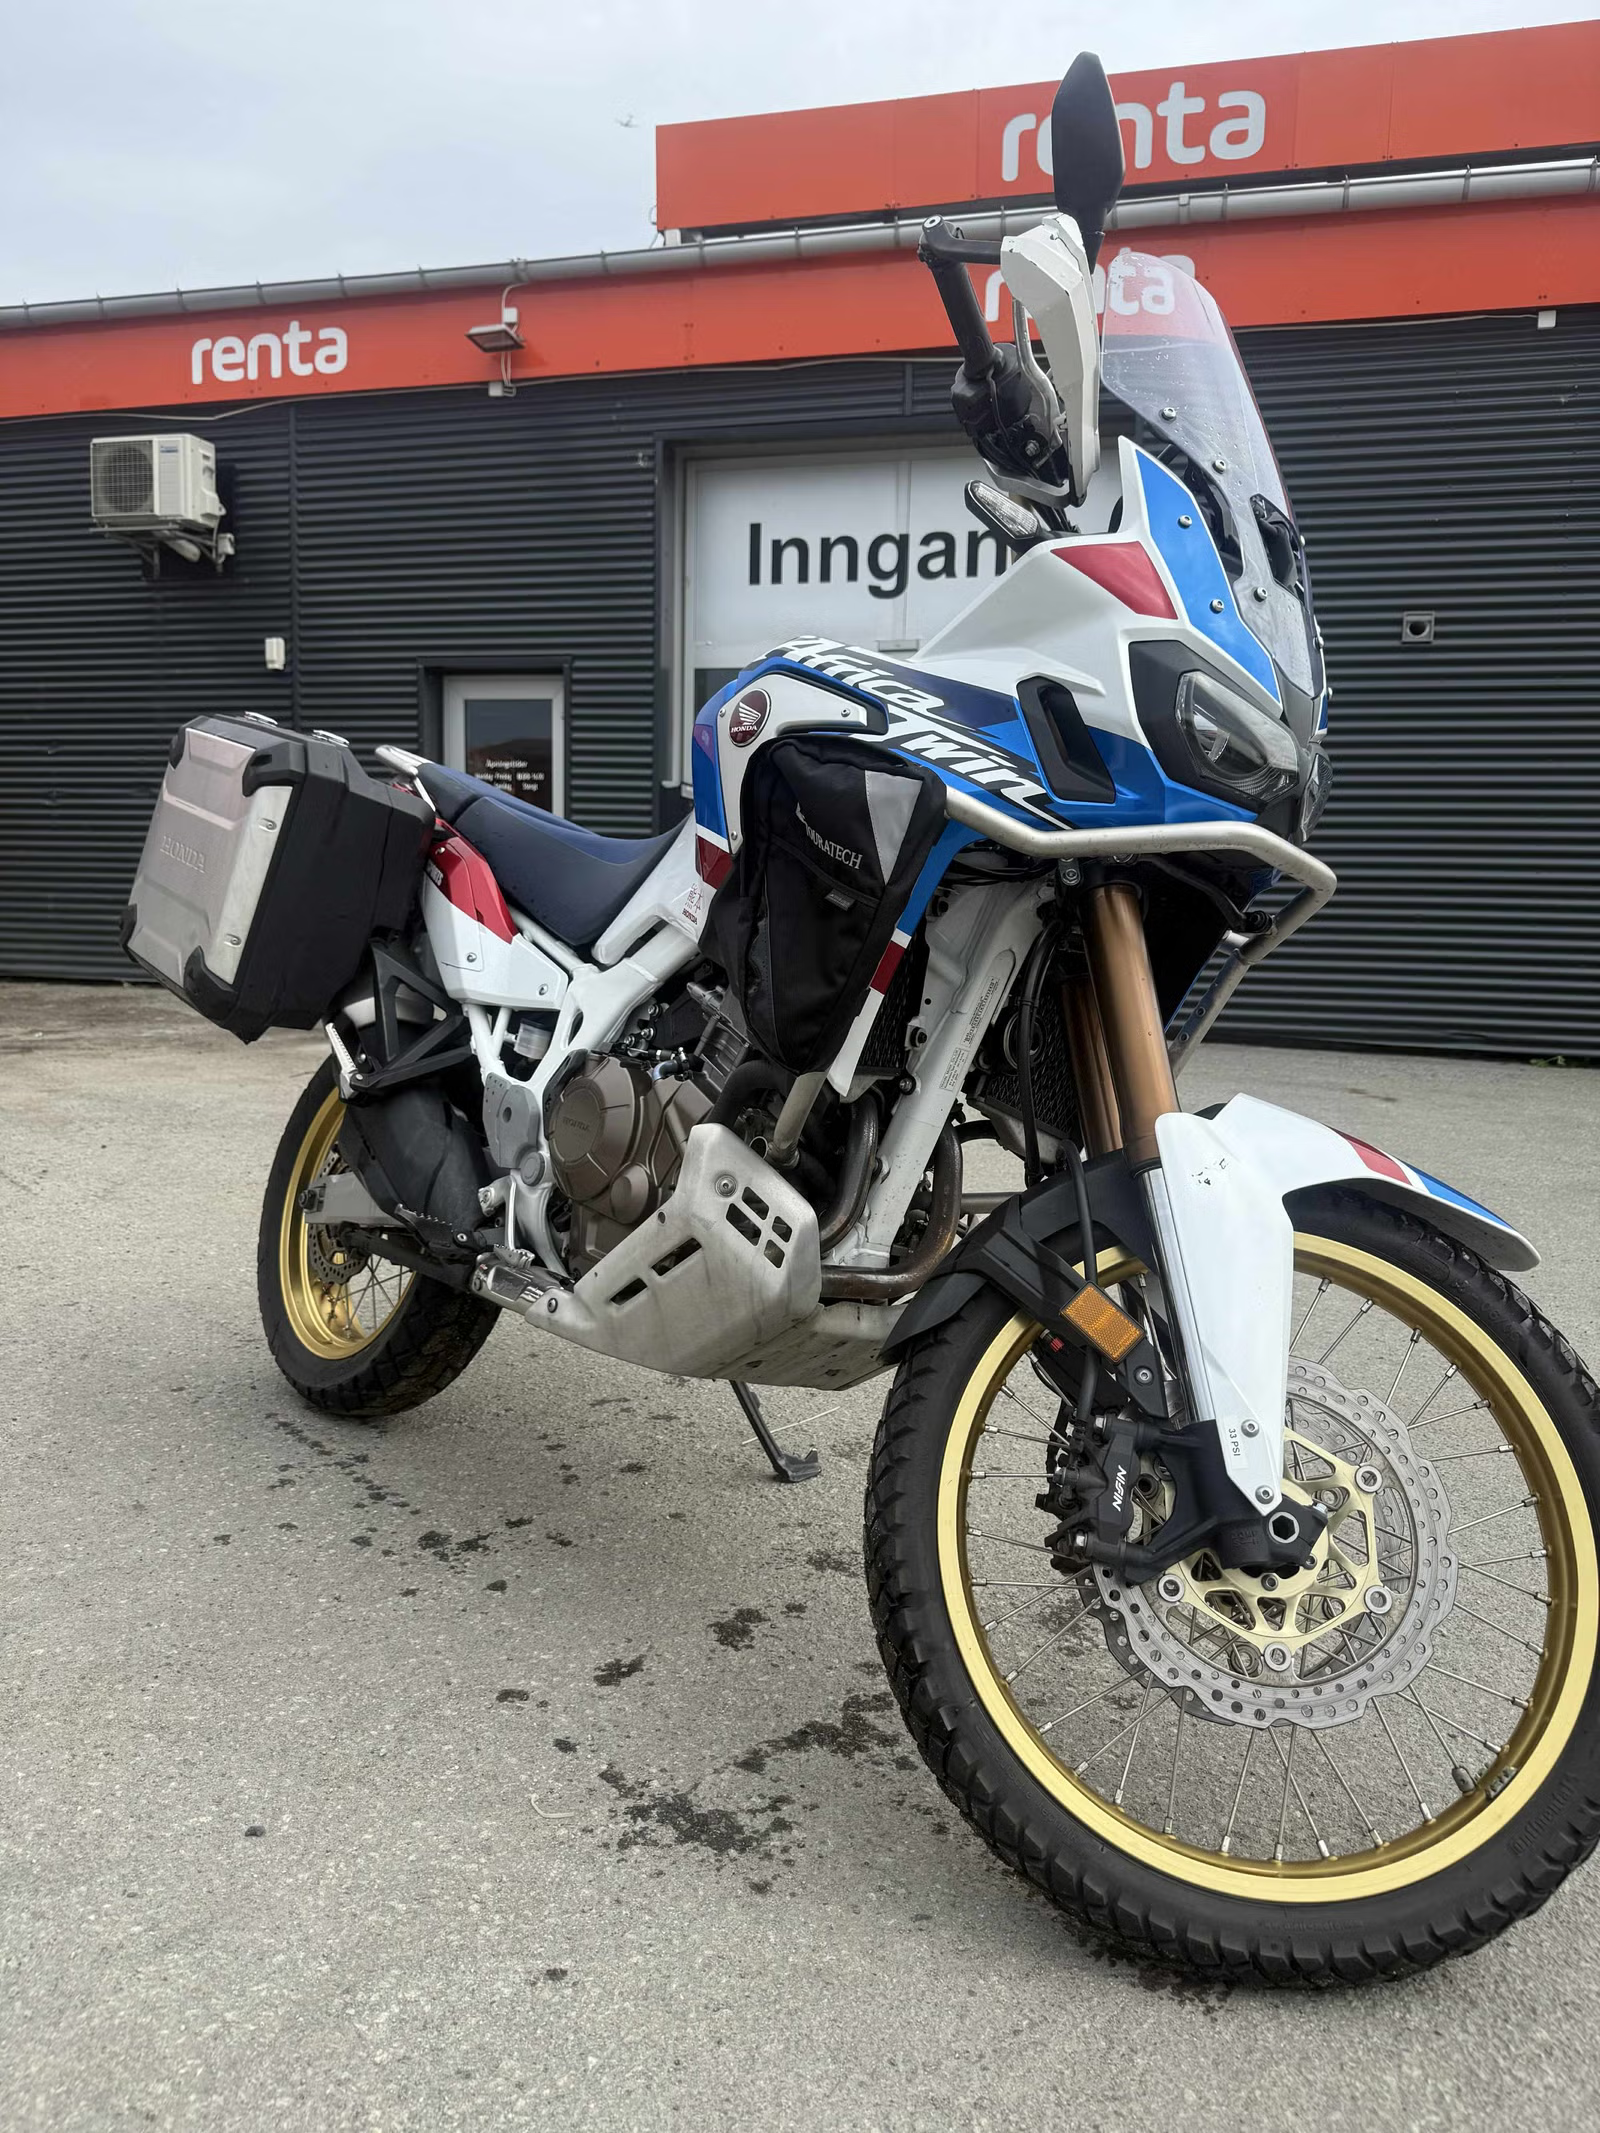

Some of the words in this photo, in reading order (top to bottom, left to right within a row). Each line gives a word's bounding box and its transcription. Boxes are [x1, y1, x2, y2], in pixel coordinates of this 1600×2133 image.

[985, 247, 1196, 322] rta
[191, 320, 348, 385] renta
[765, 635, 962, 723] Africa
[731, 724, 758, 733] HONDA
[159, 835, 205, 874] HONDA
[1228, 1428, 1238, 1439] 33
[1230, 1441, 1241, 1457] PSI
